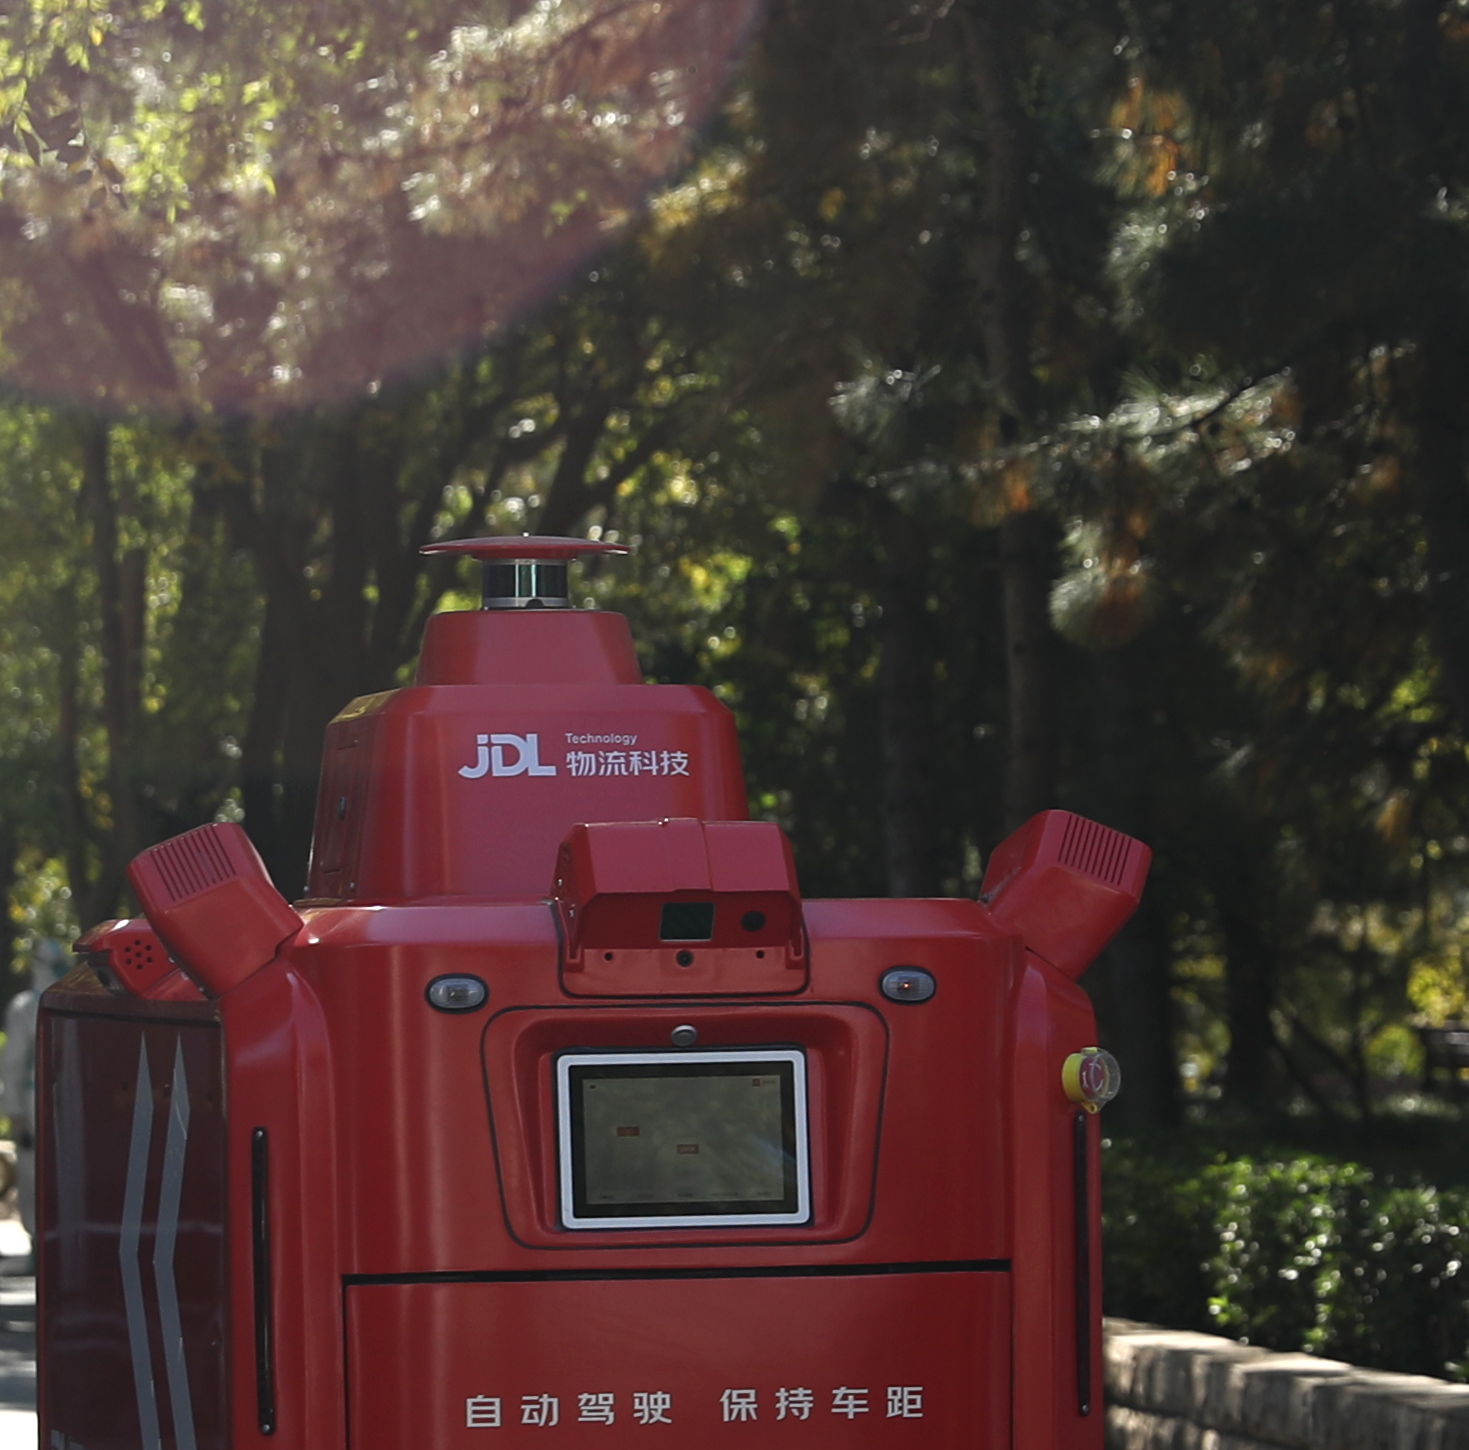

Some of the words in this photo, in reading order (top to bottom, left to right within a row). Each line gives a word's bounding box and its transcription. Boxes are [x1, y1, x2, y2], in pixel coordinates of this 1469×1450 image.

[458, 733, 557, 779] JDL
[565, 732, 638, 746] Technology
[566, 750, 691, 777] 物流科技
[466, 1390, 673, 1429] 自动驾驶
[719, 1386, 925, 1423] 保持车距
